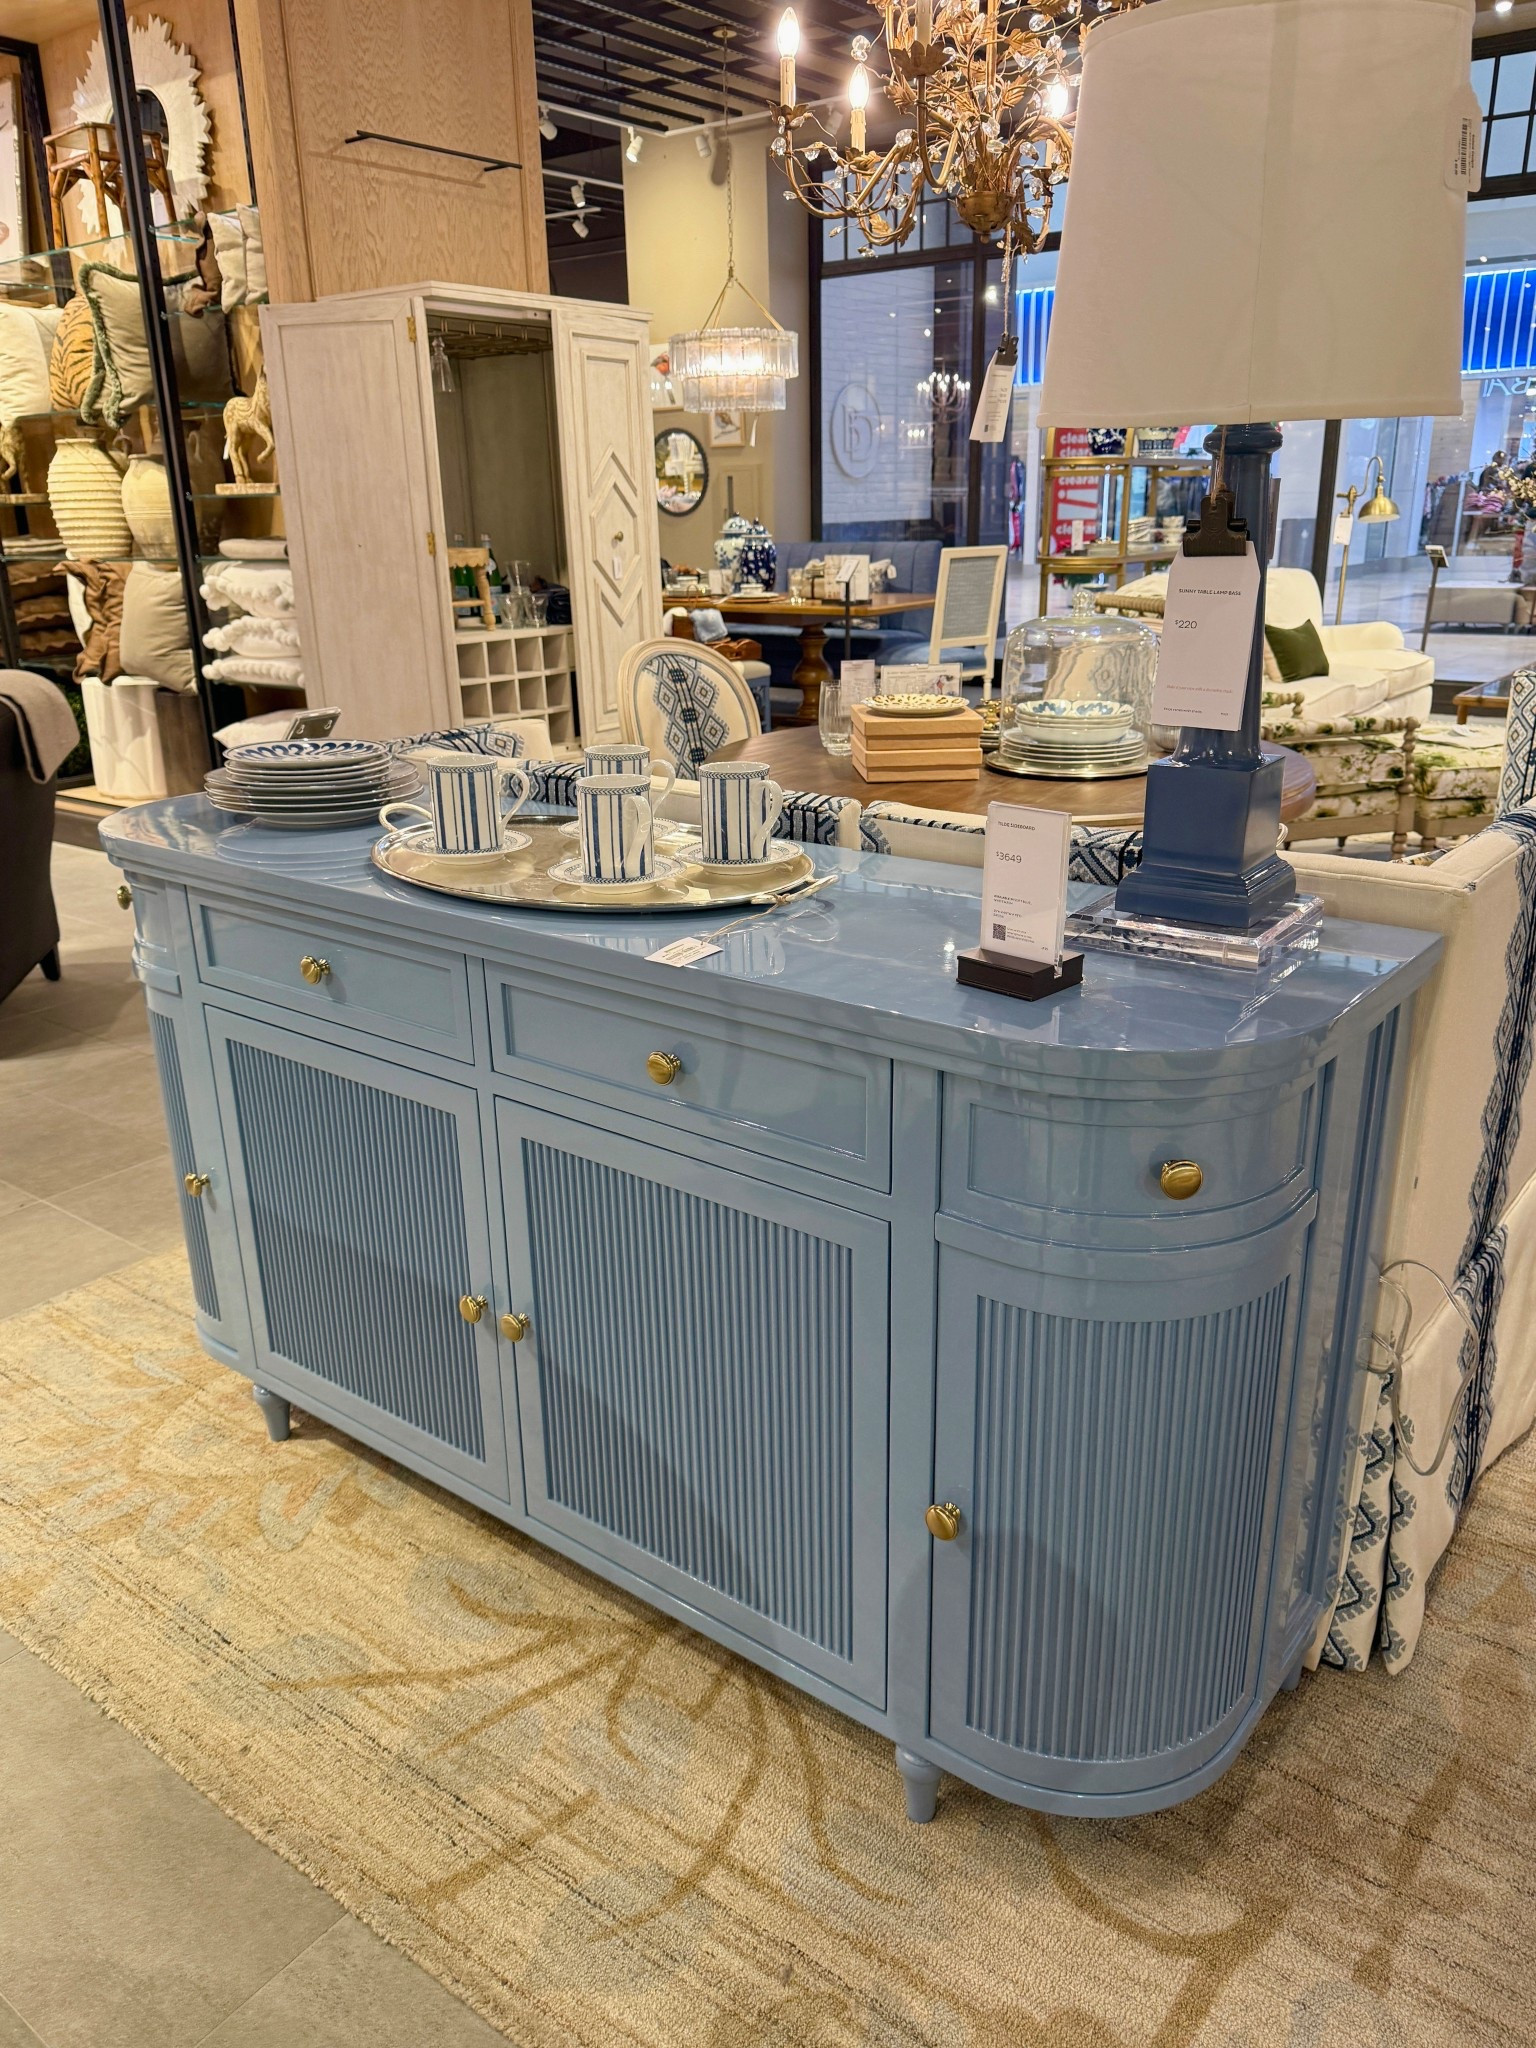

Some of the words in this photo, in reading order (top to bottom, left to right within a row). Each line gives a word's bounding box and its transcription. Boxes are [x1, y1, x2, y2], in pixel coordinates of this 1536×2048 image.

[1174, 619, 1198, 629] $220
[1010, 823, 1036, 831] SIDEBOARD
[995, 851, 1022, 864] $3649
